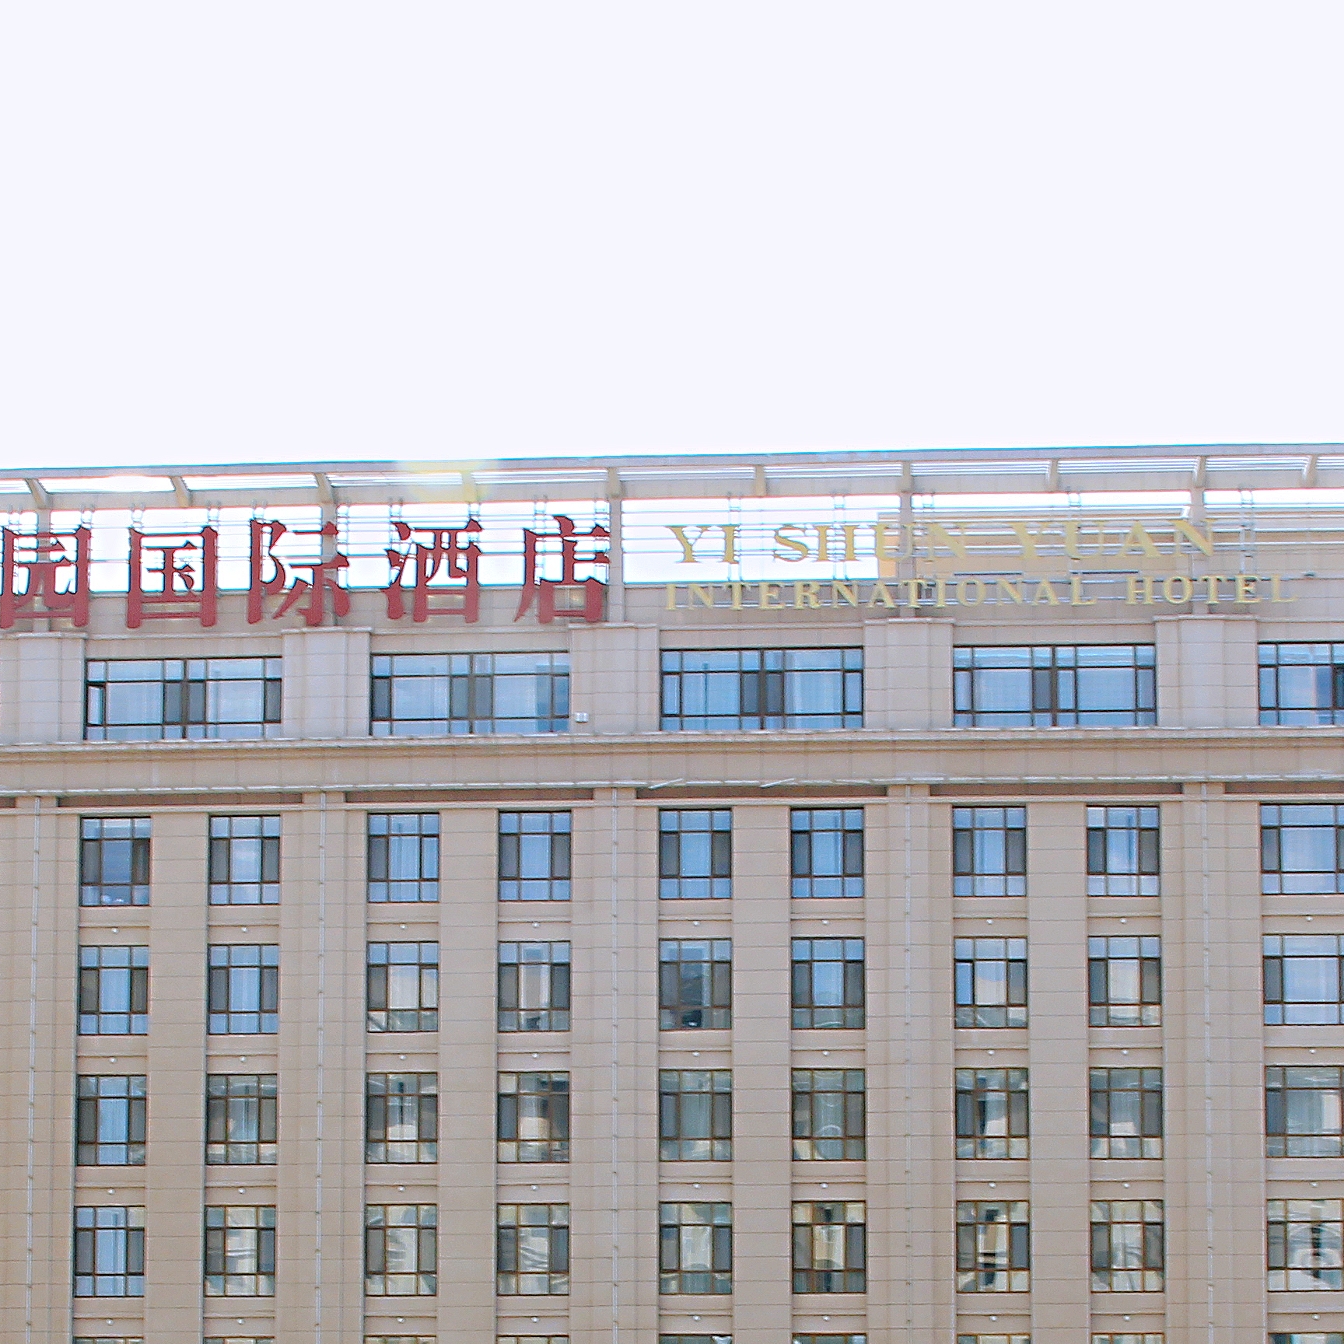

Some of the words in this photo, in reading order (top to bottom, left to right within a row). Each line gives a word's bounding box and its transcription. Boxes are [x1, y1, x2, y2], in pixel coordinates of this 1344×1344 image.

[668, 523, 740, 564] YI
[771, 521, 971, 562] SHUN
[1008, 518, 1218, 560] YUAN
[665, 575, 1101, 612] INTERNATIONAL
[1126, 572, 1301, 606] HOTEL
